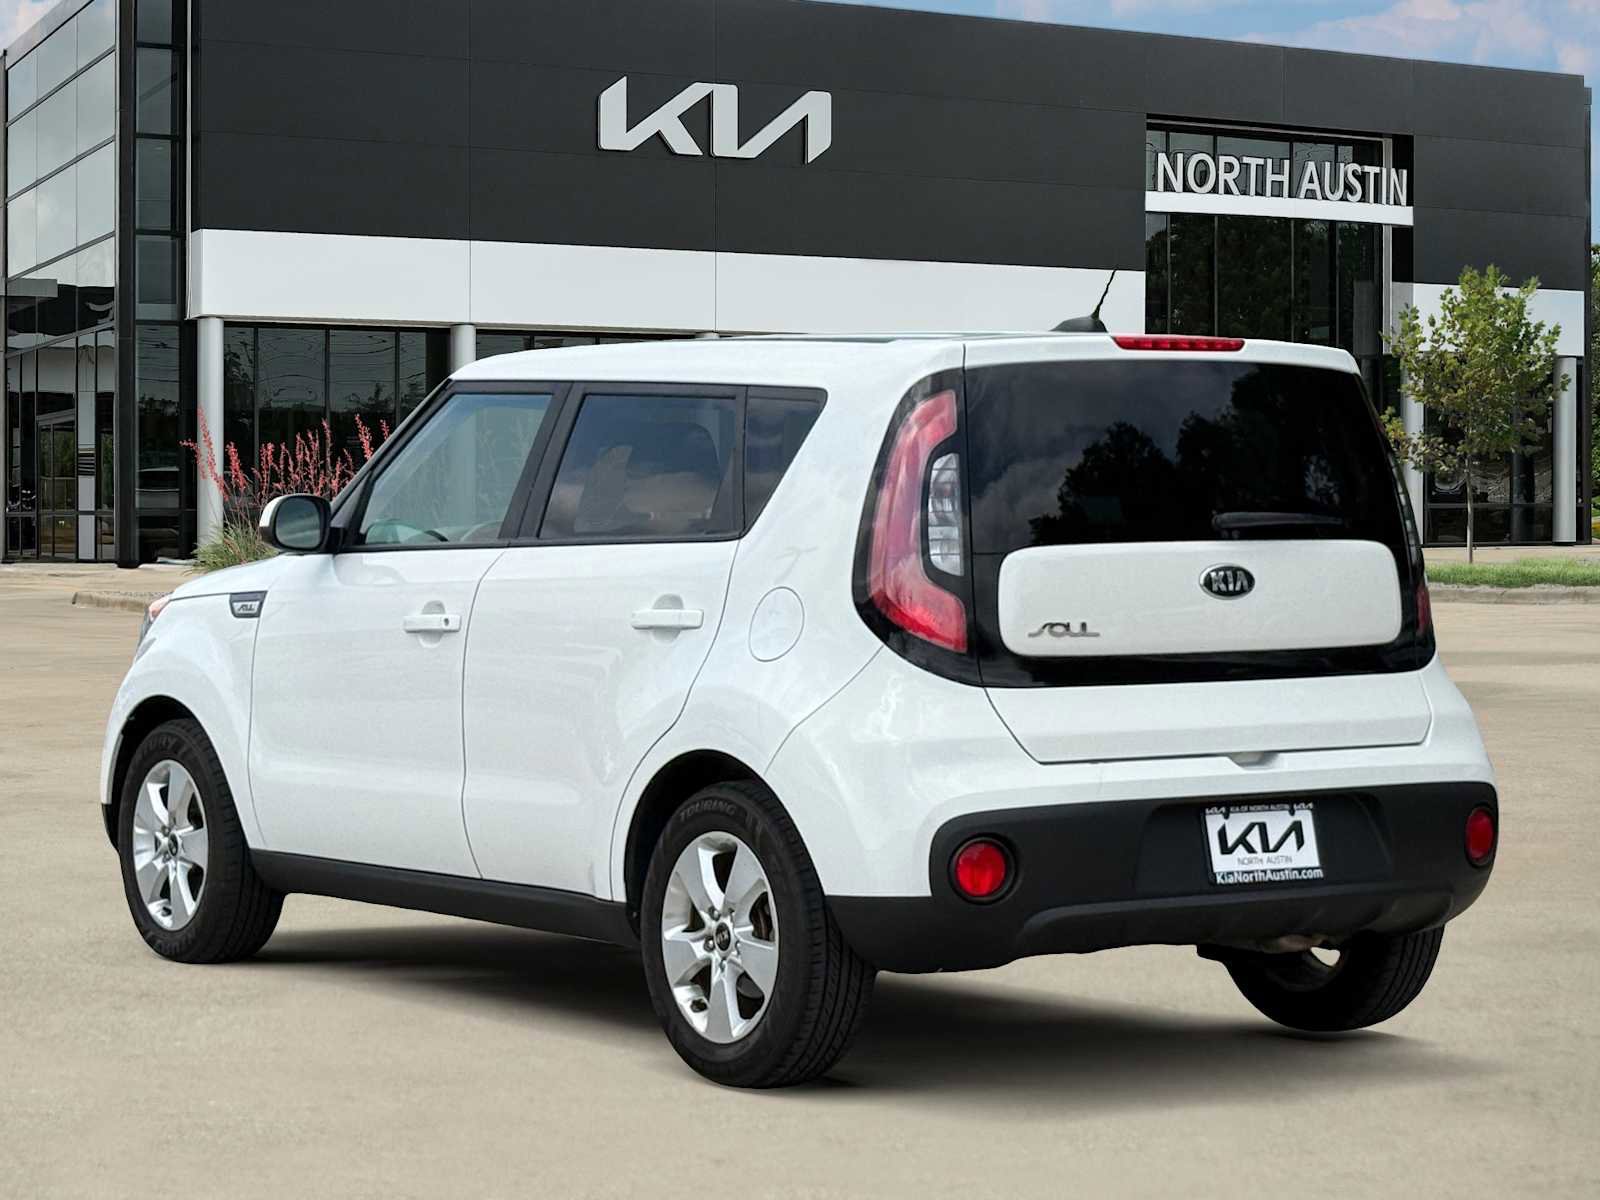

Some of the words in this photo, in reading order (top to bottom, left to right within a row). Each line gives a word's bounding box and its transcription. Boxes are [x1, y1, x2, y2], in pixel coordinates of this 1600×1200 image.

[598, 75, 832, 165] KIA
[1156, 152, 1291, 199] NORTH
[1299, 160, 1408, 207] AUSTIN
[1209, 570, 1248, 592] KIA
[1217, 820, 1305, 855] KIA
[1237, 857, 1263, 865] NORTH
[1266, 855, 1293, 864] AUSTIN
[1216, 868, 1324, 884] KiaNorthAustin.com
